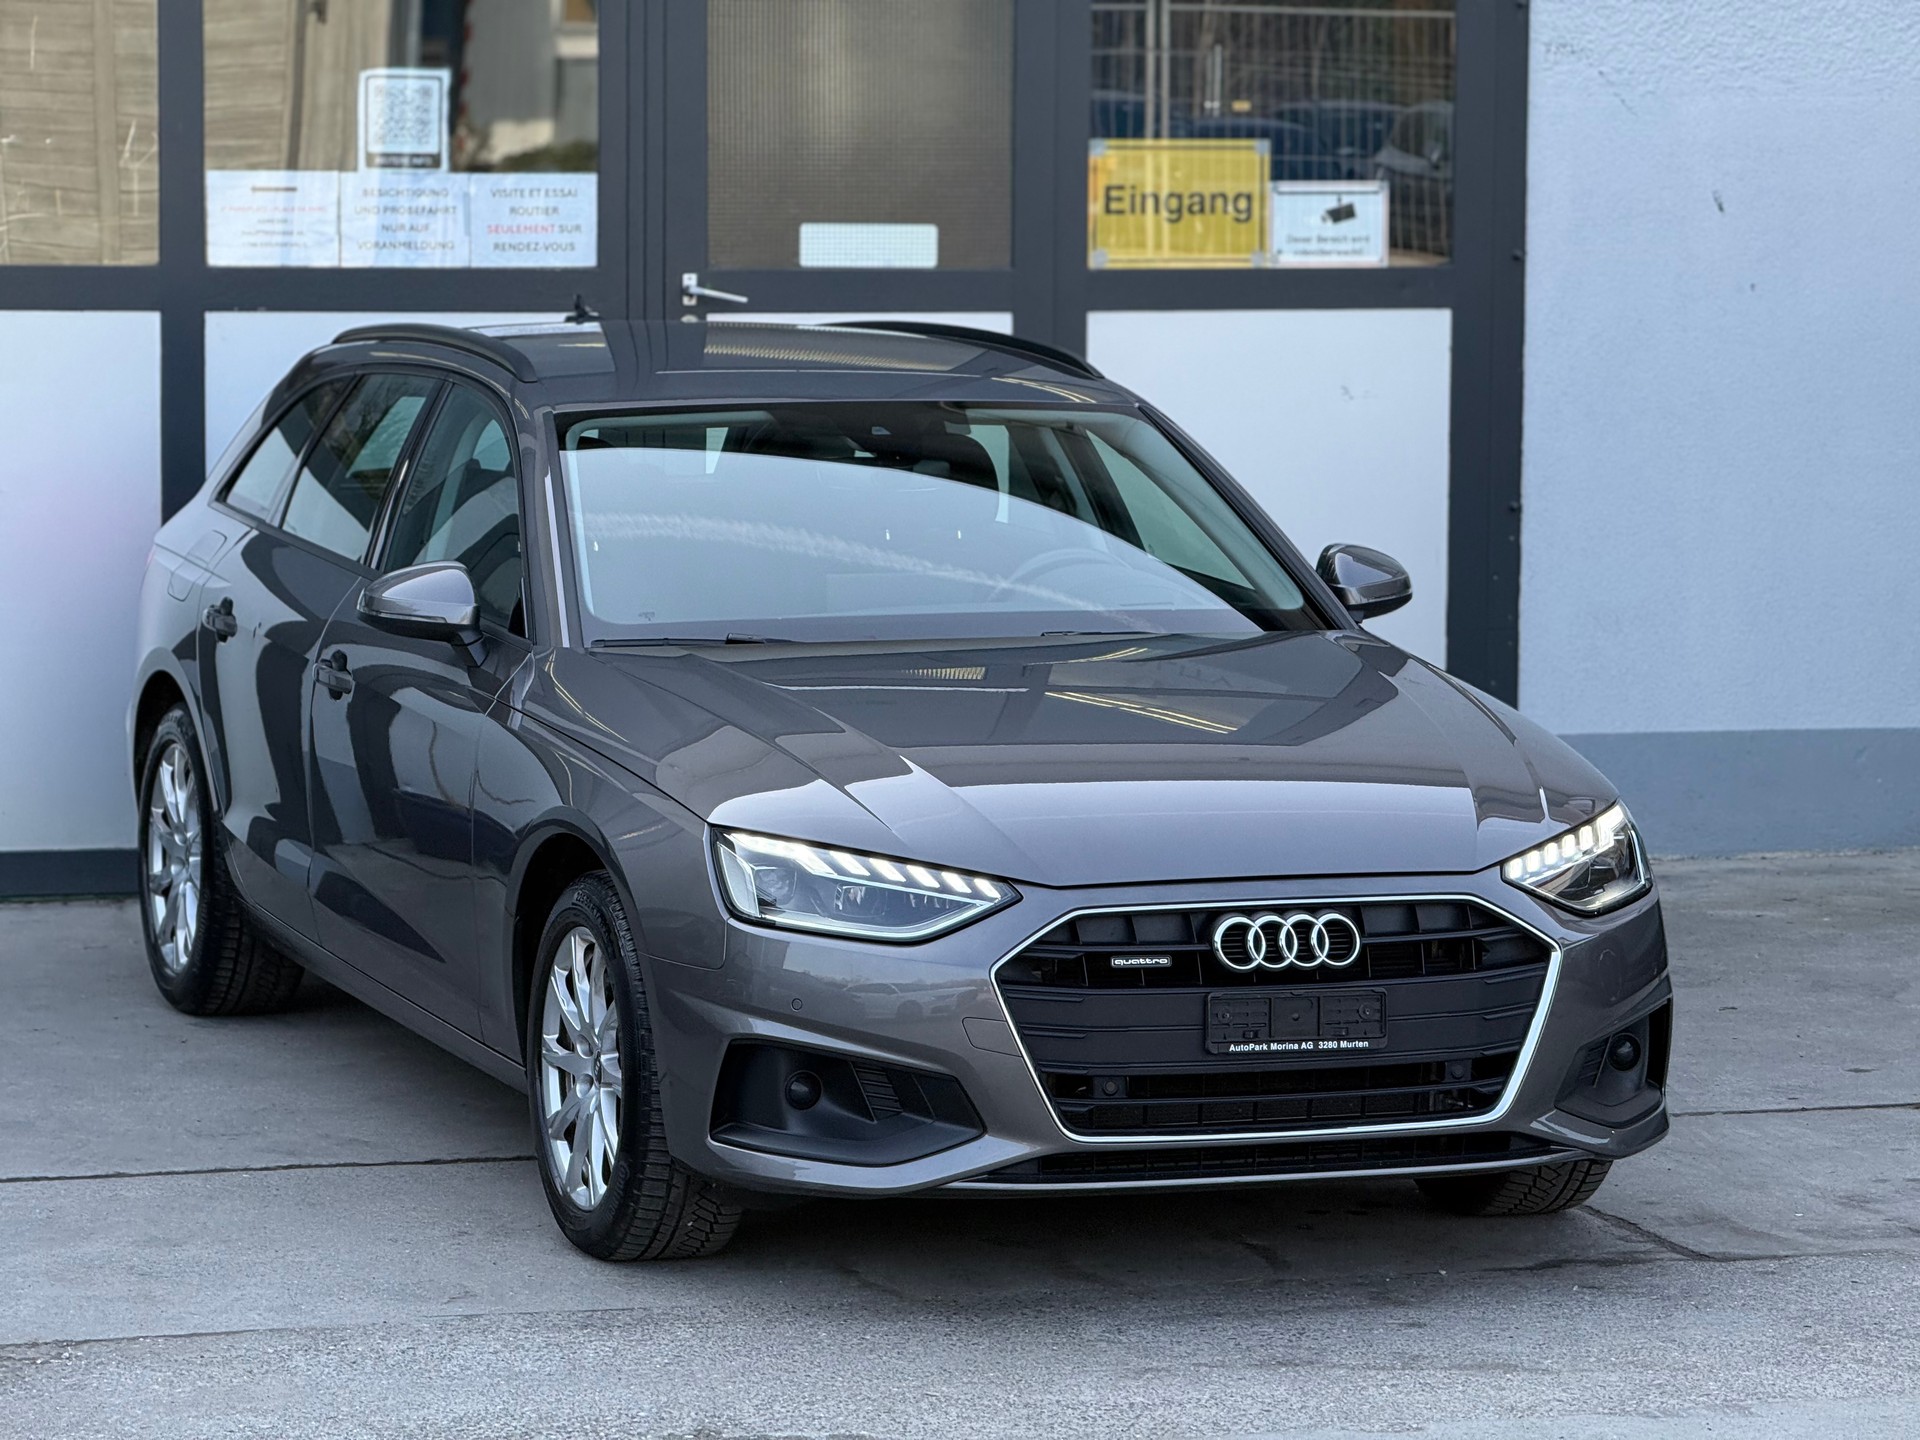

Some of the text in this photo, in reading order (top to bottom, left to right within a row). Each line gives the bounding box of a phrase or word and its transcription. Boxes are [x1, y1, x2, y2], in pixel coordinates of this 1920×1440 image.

[490, 188, 578, 198] VISITE ET ESSAI
[1104, 185, 1254, 223] Eingang
[509, 206, 560, 217] ROUTIER
[381, 223, 430, 234] NUR AUF
[487, 224, 582, 235] SEULEMENT SUR
[493, 242, 576, 253] RENDEZ-VOUS
[1114, 957, 1168, 966] quattro
[1228, 1039, 1369, 1052] AutoPark Morina AG 3280 Murten
